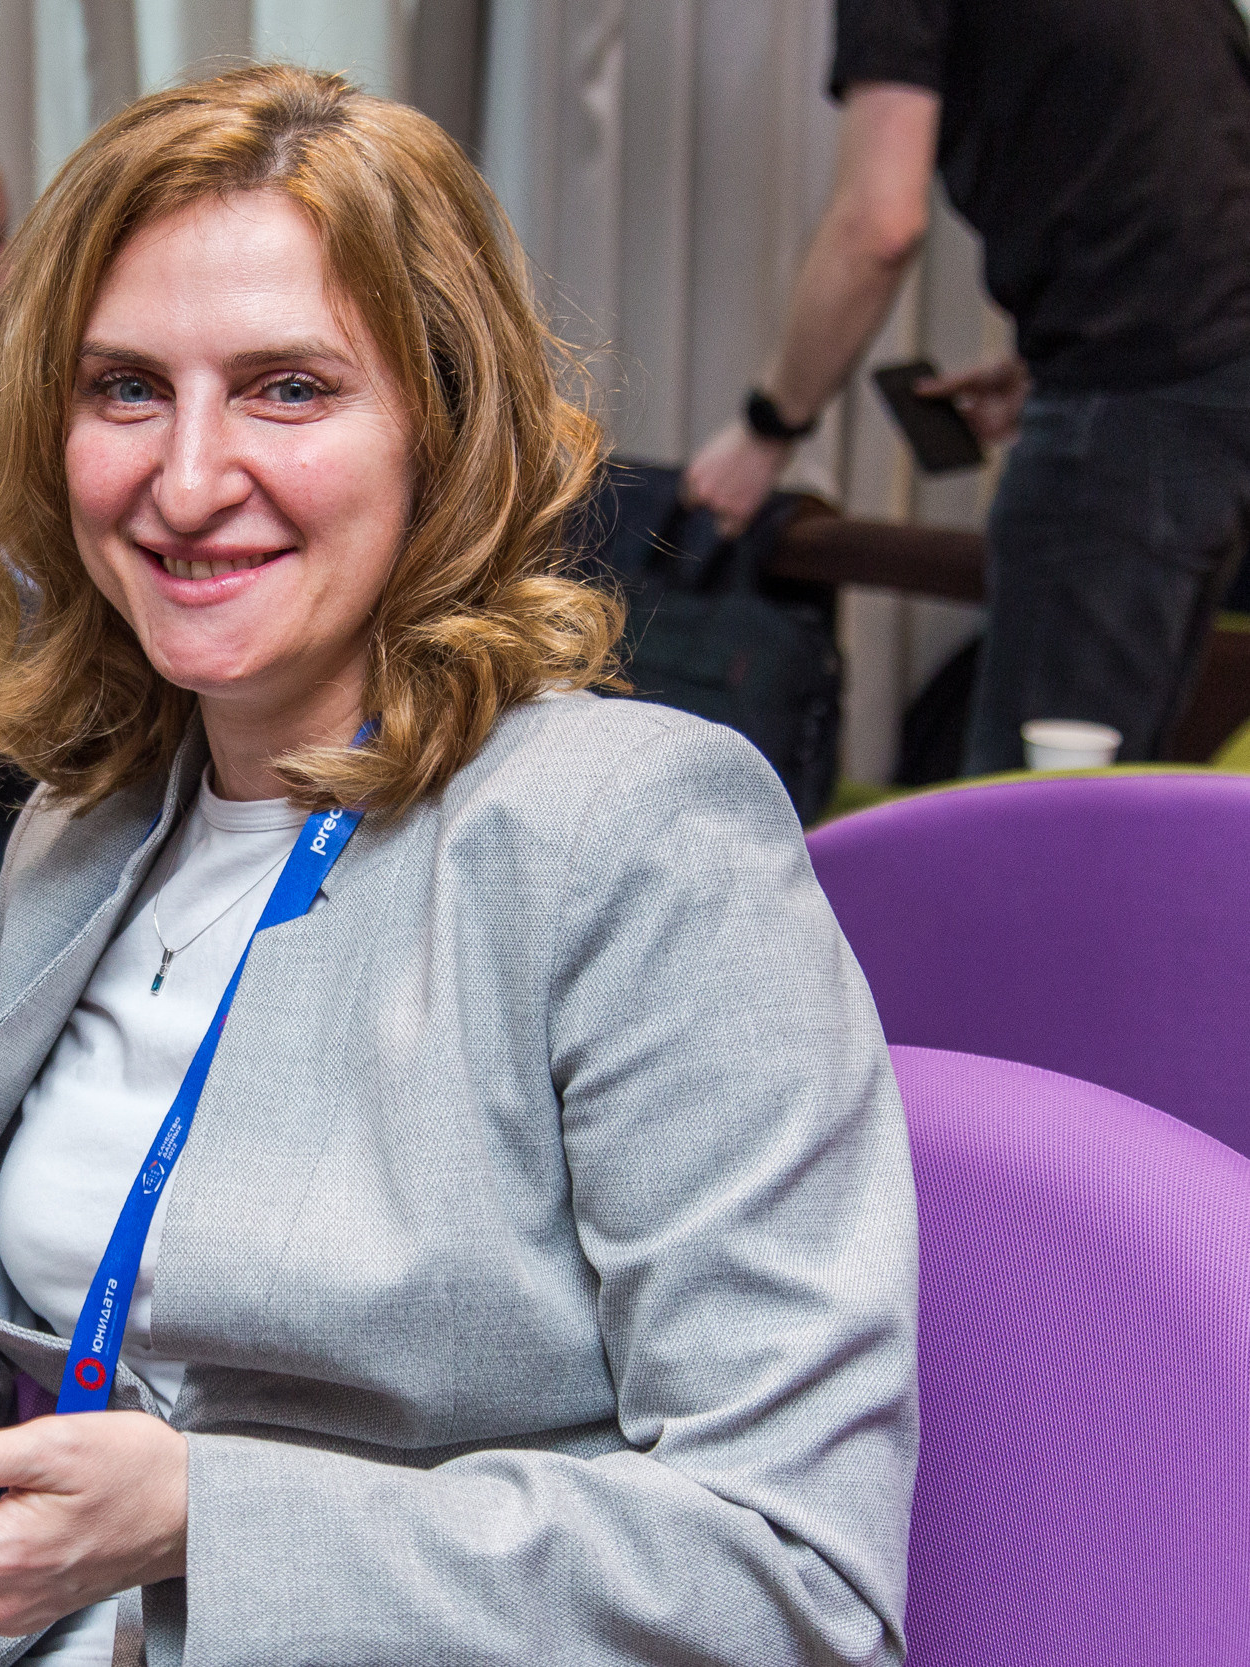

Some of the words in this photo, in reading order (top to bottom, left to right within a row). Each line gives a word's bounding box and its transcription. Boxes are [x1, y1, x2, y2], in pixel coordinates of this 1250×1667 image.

[157, 1116, 181, 1157] КАЧЕСТВО
[162, 1124, 182, 1158] ДАННЫХ
[166, 1142, 178, 1161] 2022
